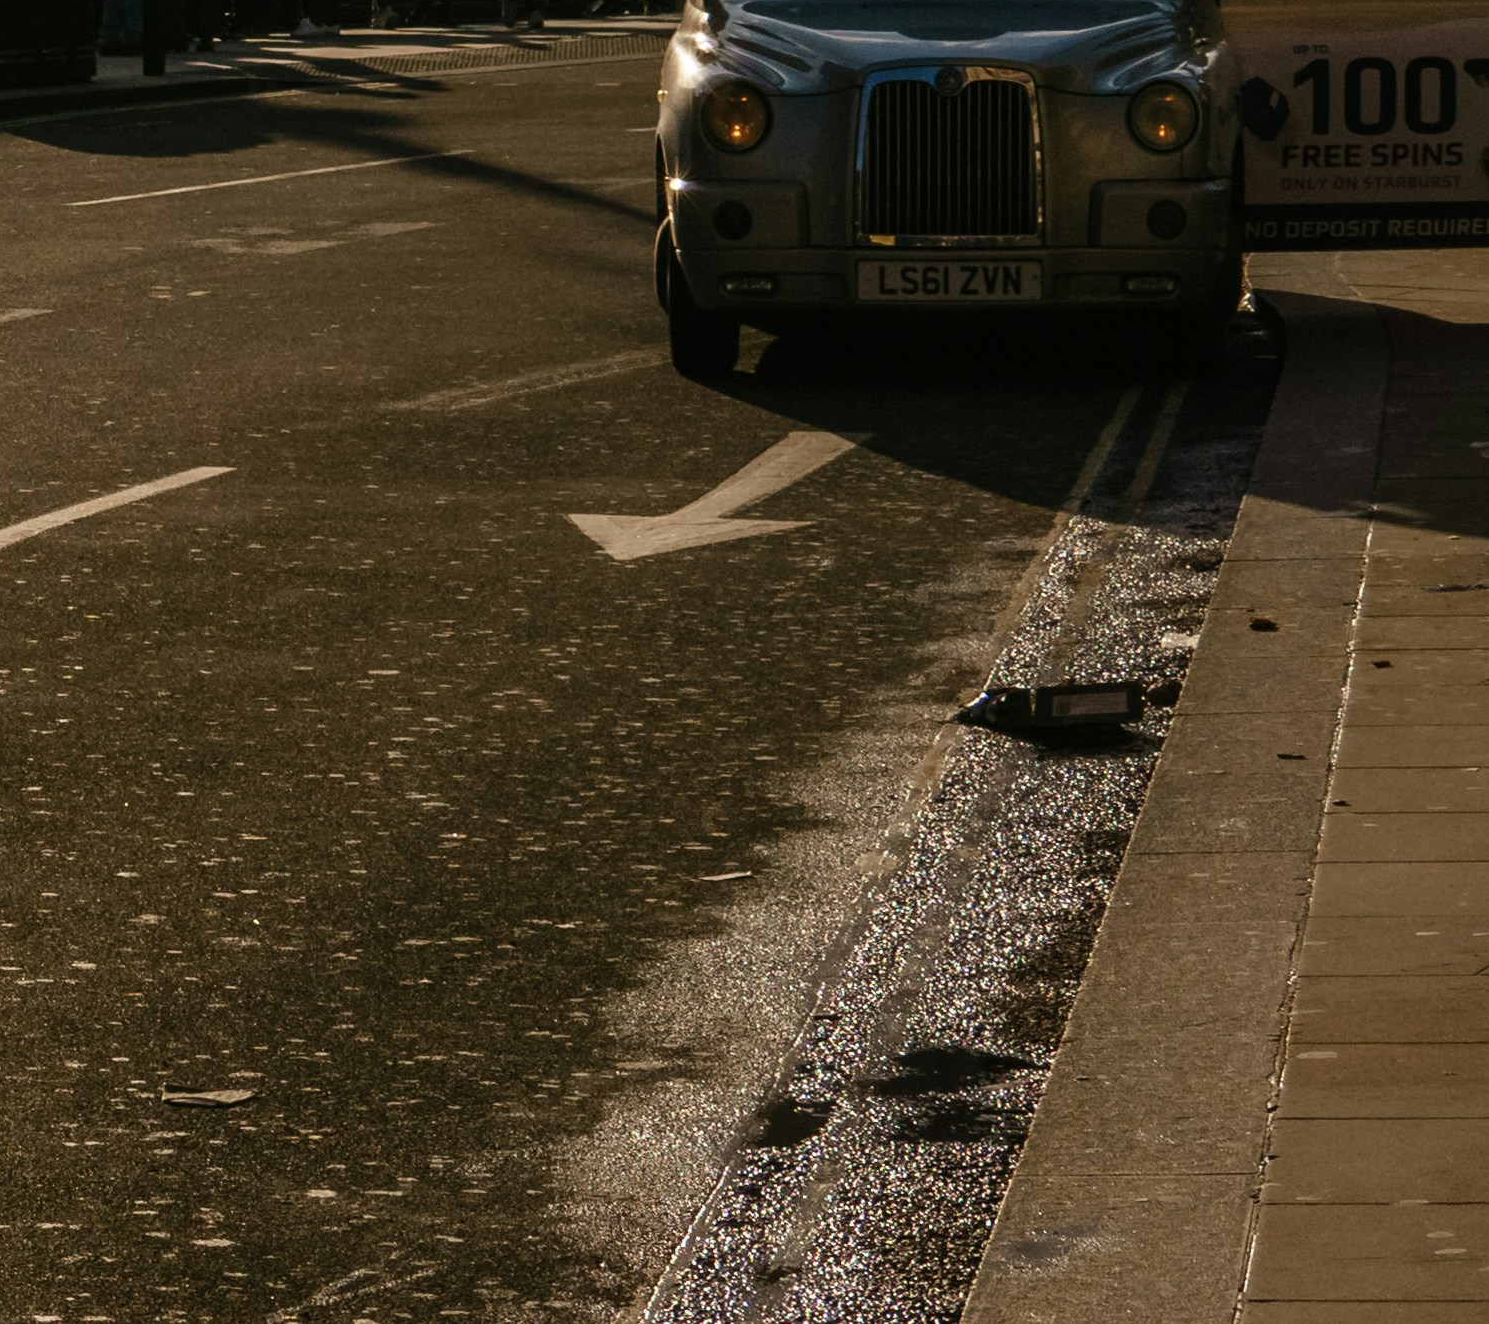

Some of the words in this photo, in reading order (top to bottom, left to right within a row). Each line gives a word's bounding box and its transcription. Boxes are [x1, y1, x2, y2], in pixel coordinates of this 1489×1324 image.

[1293, 45, 1309, 54] UP
[1312, 45, 1329, 54] TO
[1293, 56, 1457, 135] 100
[1282, 144, 1362, 168] FREE
[1371, 143, 1464, 167] SPINS
[1281, 178, 1327, 191] ONLY
[1334, 178, 1358, 189] ON
[1364, 175, 1461, 190] STARBURST
[1244, 221, 1279, 239] NO
[1285, 219, 1382, 238] DEPOSIT
[1387, 217, 1489, 237] REQUIRE
[879, 266, 950, 295] LS61
[960, 266, 1022, 295] ZVN
